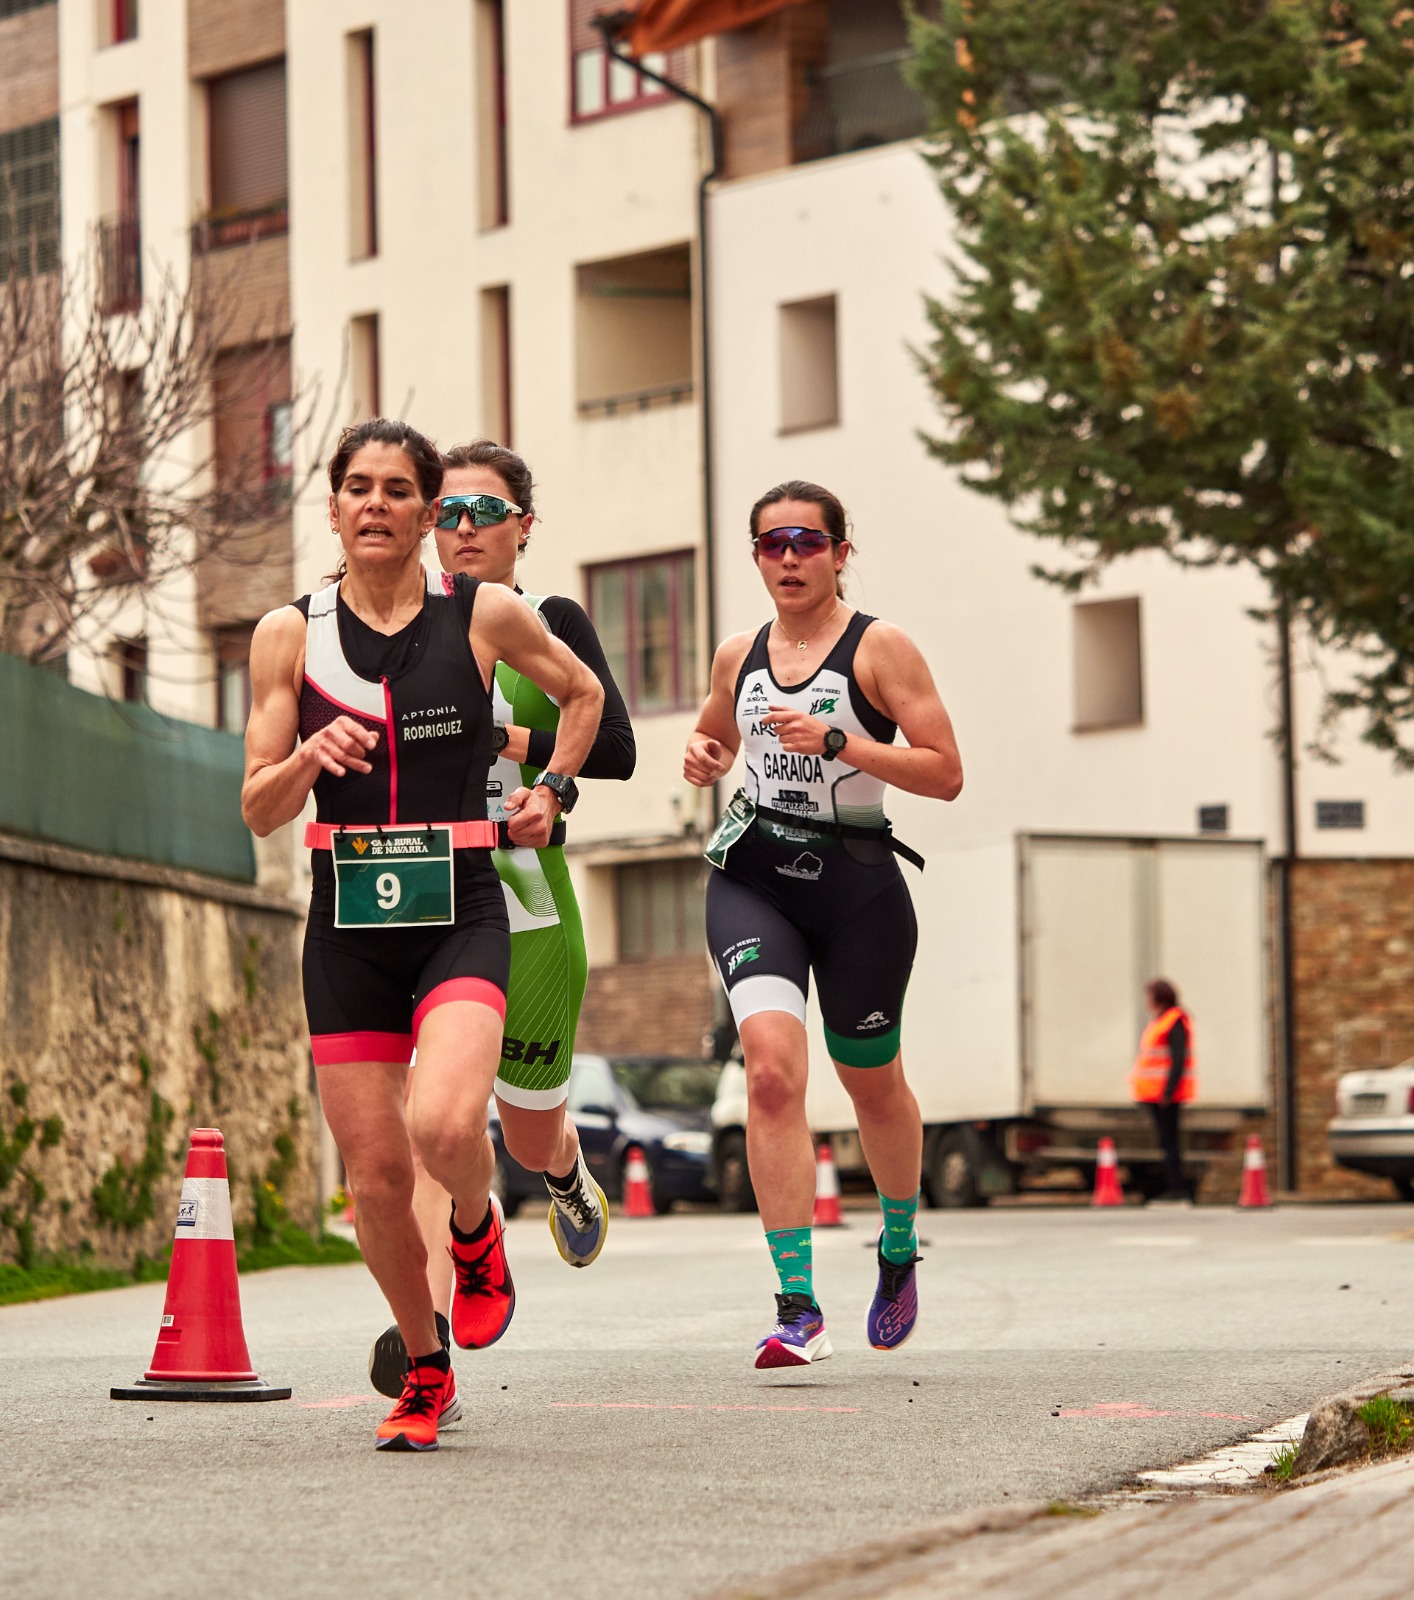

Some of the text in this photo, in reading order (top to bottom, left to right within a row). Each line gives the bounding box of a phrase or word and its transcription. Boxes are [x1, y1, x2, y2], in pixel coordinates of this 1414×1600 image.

[401, 705, 457, 721] APTONIA
[403, 720, 463, 741] RODRIGUEZ
[763, 753, 825, 784] GARAIOA
[772, 800, 817, 811] muruzabal
[370, 837, 424, 847] CAA RURAL
[371, 845, 429, 855] DE NAVARRA
[375, 872, 401, 909] 9
[501, 1036, 561, 1066] BH
